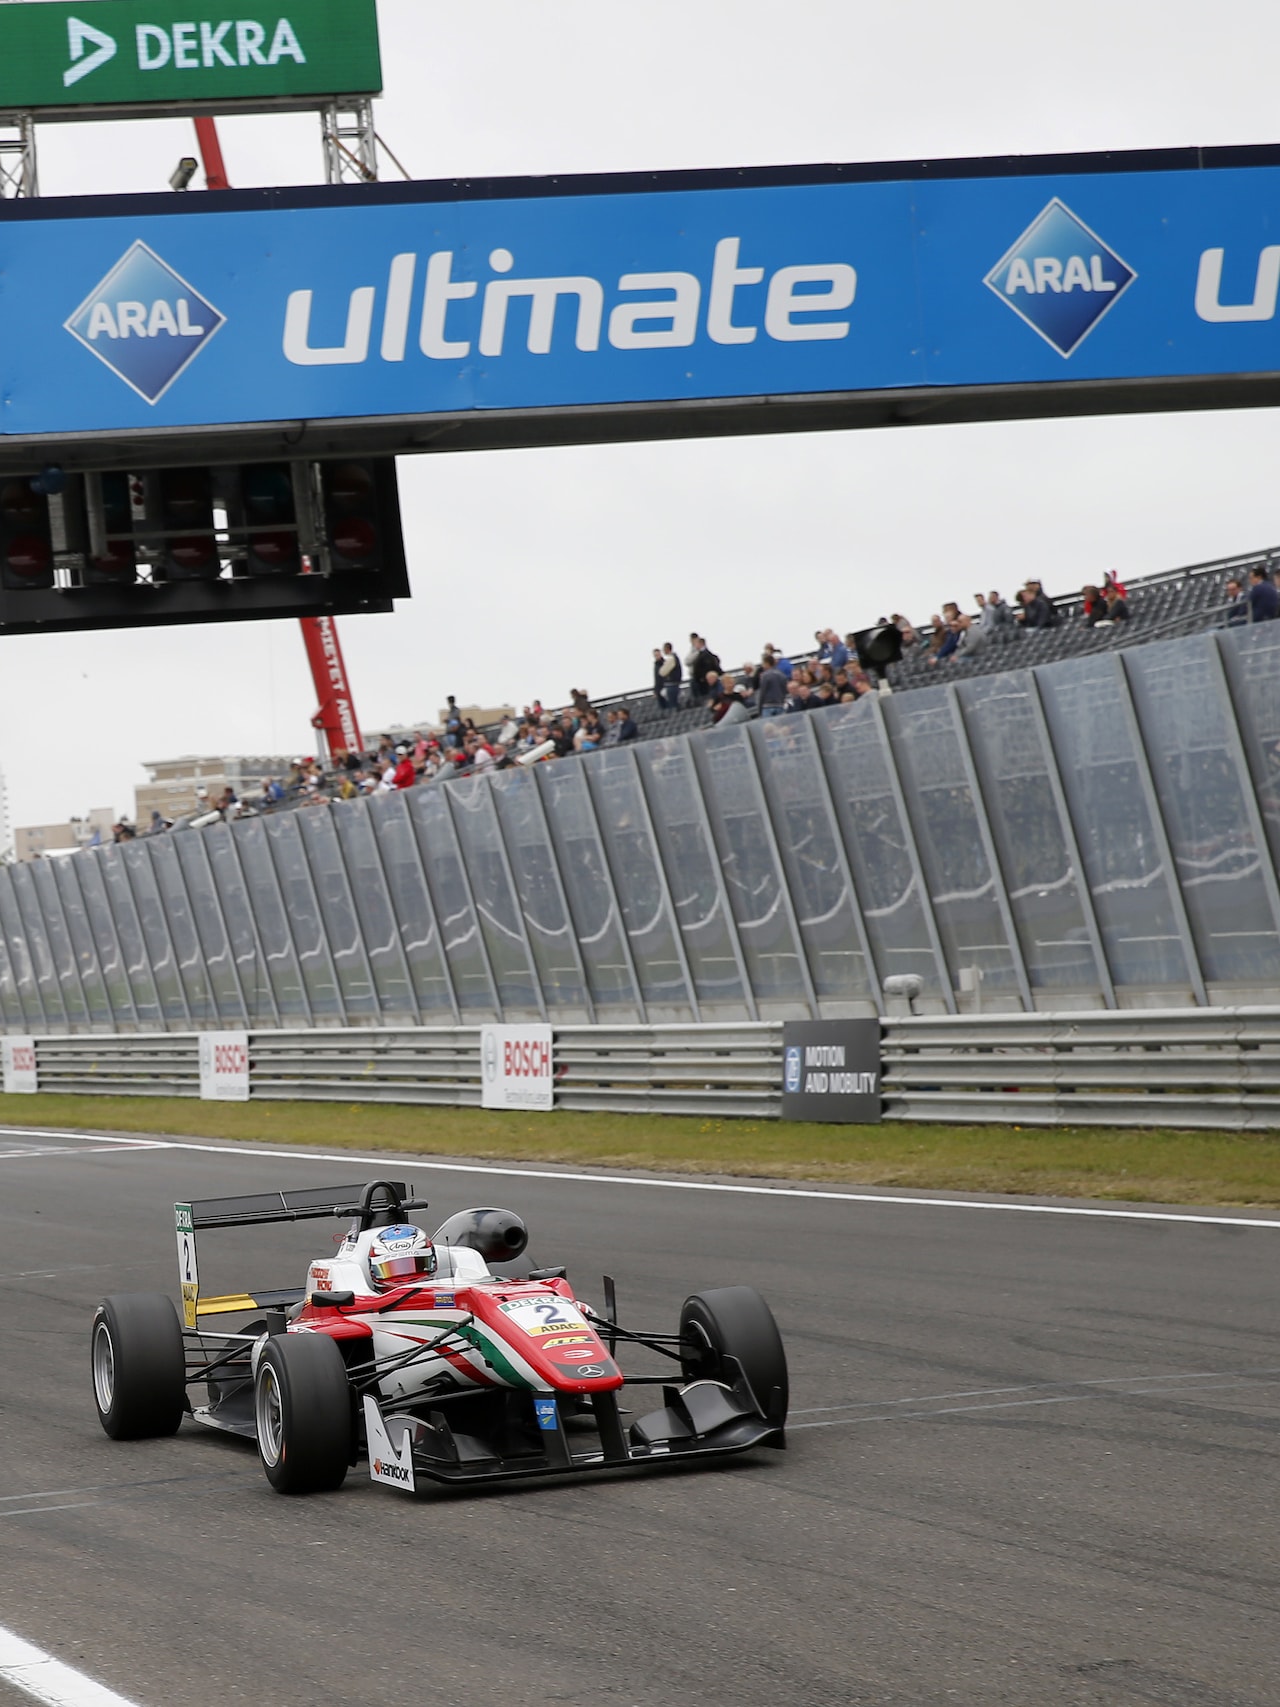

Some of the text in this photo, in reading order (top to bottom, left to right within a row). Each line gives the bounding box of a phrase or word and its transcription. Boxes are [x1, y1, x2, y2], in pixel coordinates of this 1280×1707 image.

[136, 18, 306, 70] DEKRA
[1005, 255, 1117, 295] ARAL
[282, 237, 857, 366] ultimate
[87, 299, 204, 340] ARAL
[215, 1044, 247, 1074] BOSCH
[504, 1041, 549, 1077] BOSCH
[805, 1046, 845, 1067] MOTION
[804, 1072, 877, 1094] AND MOBILITY
[391, 1242, 409, 1250] Arai
[506, 1296, 566, 1310] DEKRA
[535, 1304, 568, 1325] 2
[541, 1323, 579, 1333] ADAC
